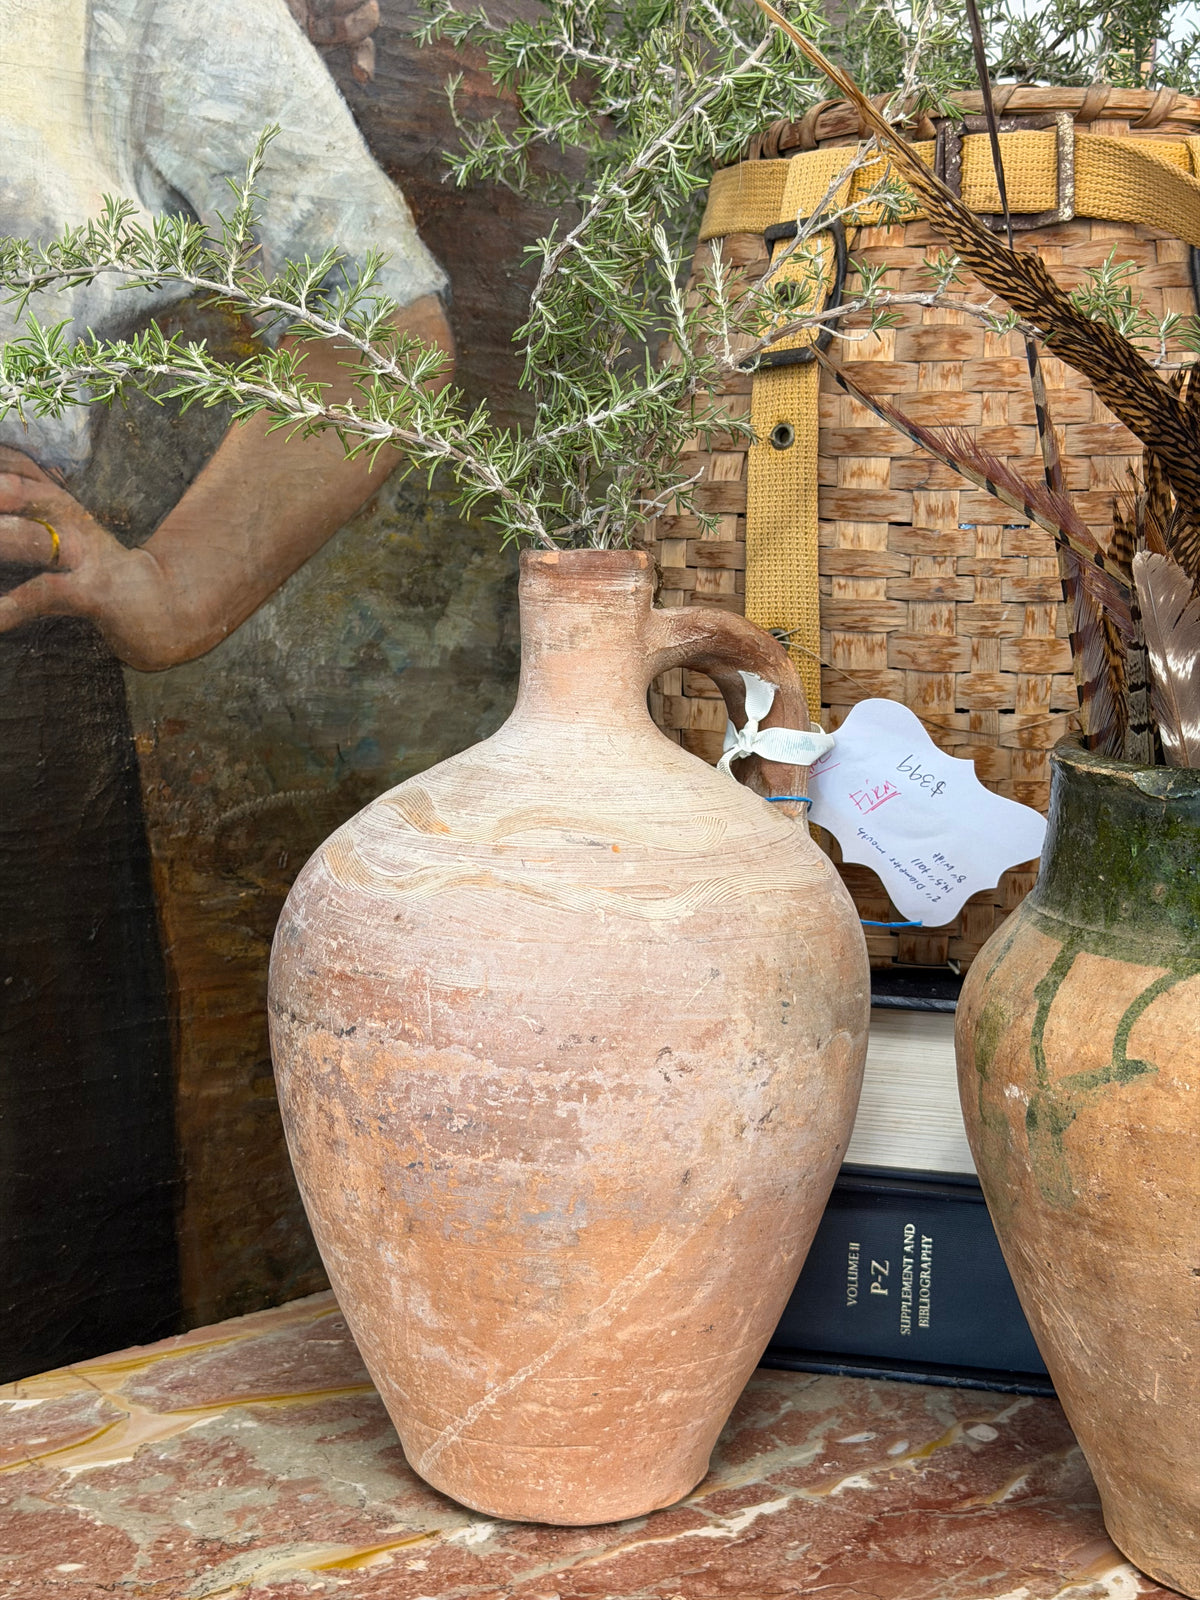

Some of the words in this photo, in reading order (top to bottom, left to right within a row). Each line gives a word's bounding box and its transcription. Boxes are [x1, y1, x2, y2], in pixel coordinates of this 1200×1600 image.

[896, 754, 946, 797] $399
[857, 827, 886, 854] mouth
[849, 1242, 860, 1251] II
[904, 1223, 915, 1253] AND
[846, 1251, 860, 1307] VOLUME
[870, 1260, 889, 1296] P-Z
[900, 1255, 914, 1336] SUPPLEMENT
[918, 1234, 933, 1328] BIBLIOGRAPHY
